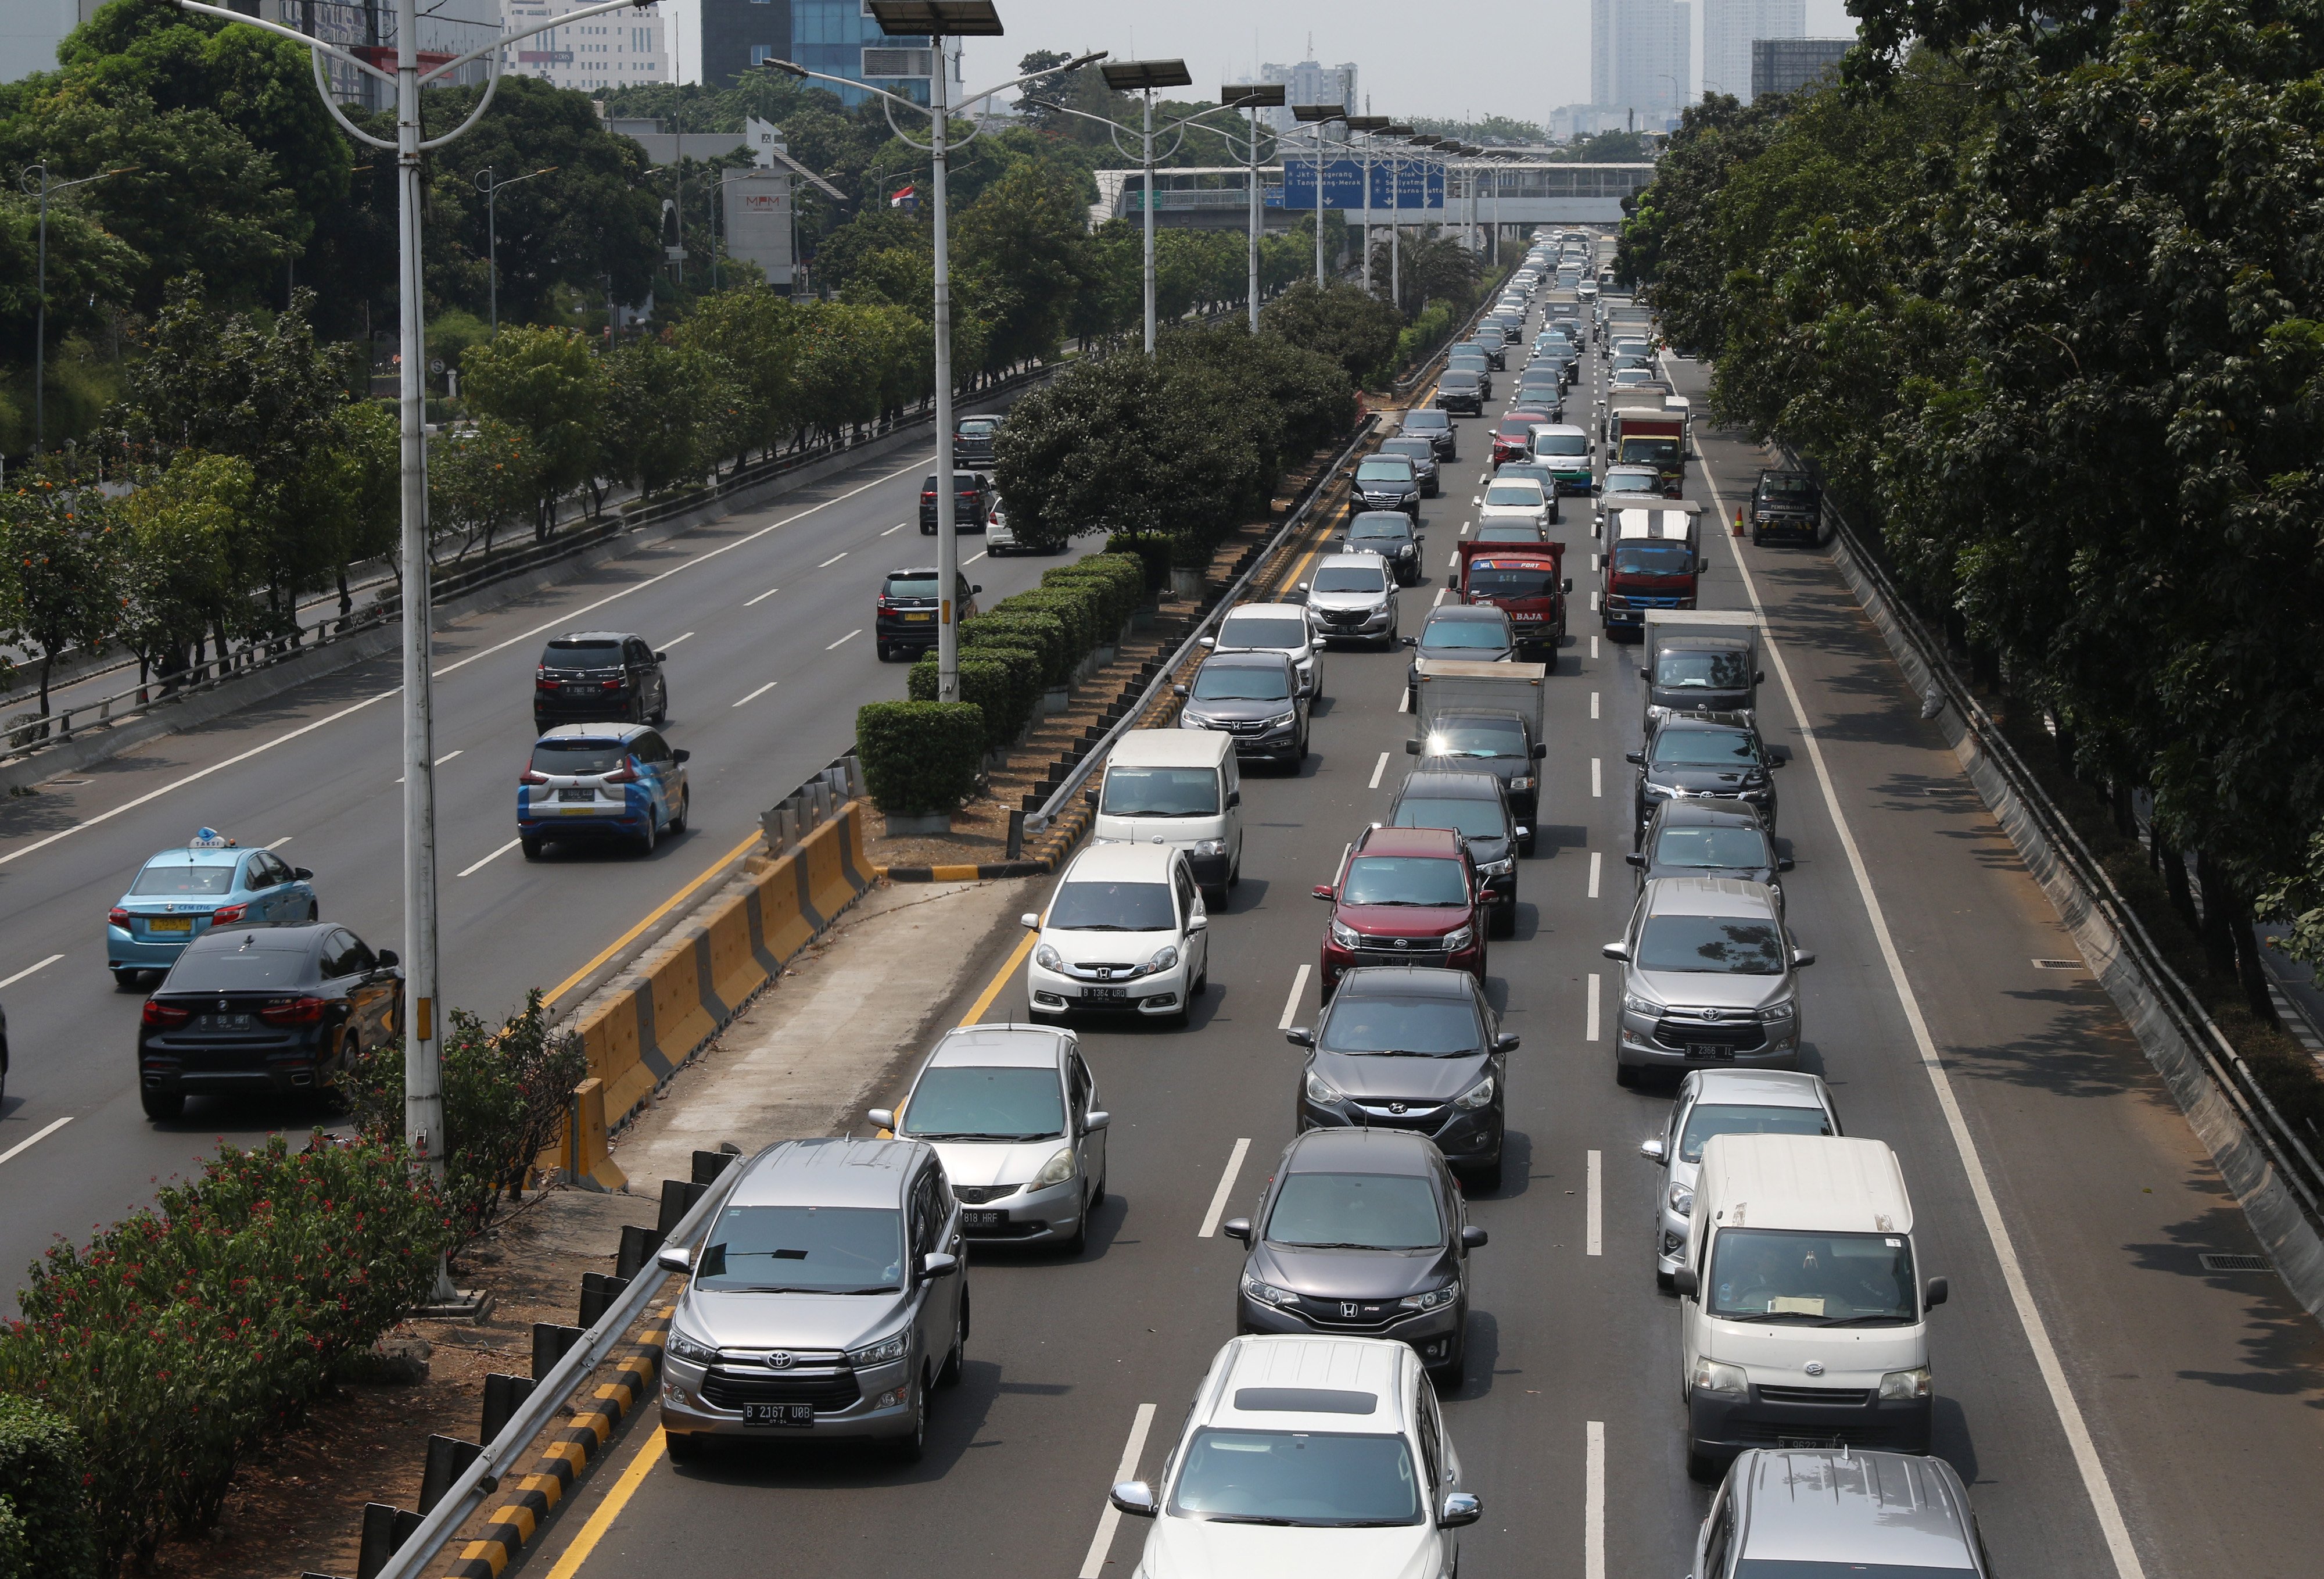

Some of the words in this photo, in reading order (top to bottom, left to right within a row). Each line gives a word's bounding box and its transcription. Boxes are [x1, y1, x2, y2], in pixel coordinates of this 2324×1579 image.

[747, 196, 780, 206] MPM
[433, 360, 442, 373] S
[1084, 989, 1088, 997] B
[1093, 989, 1109, 997] 1364
[1687, 1045, 1691, 1054] B
[1698, 1046, 1716, 1055] 2366
[1724, 1047, 1733, 1055] IL
[982, 1213, 998, 1223] HRF
[747, 1406, 753, 1417] B
